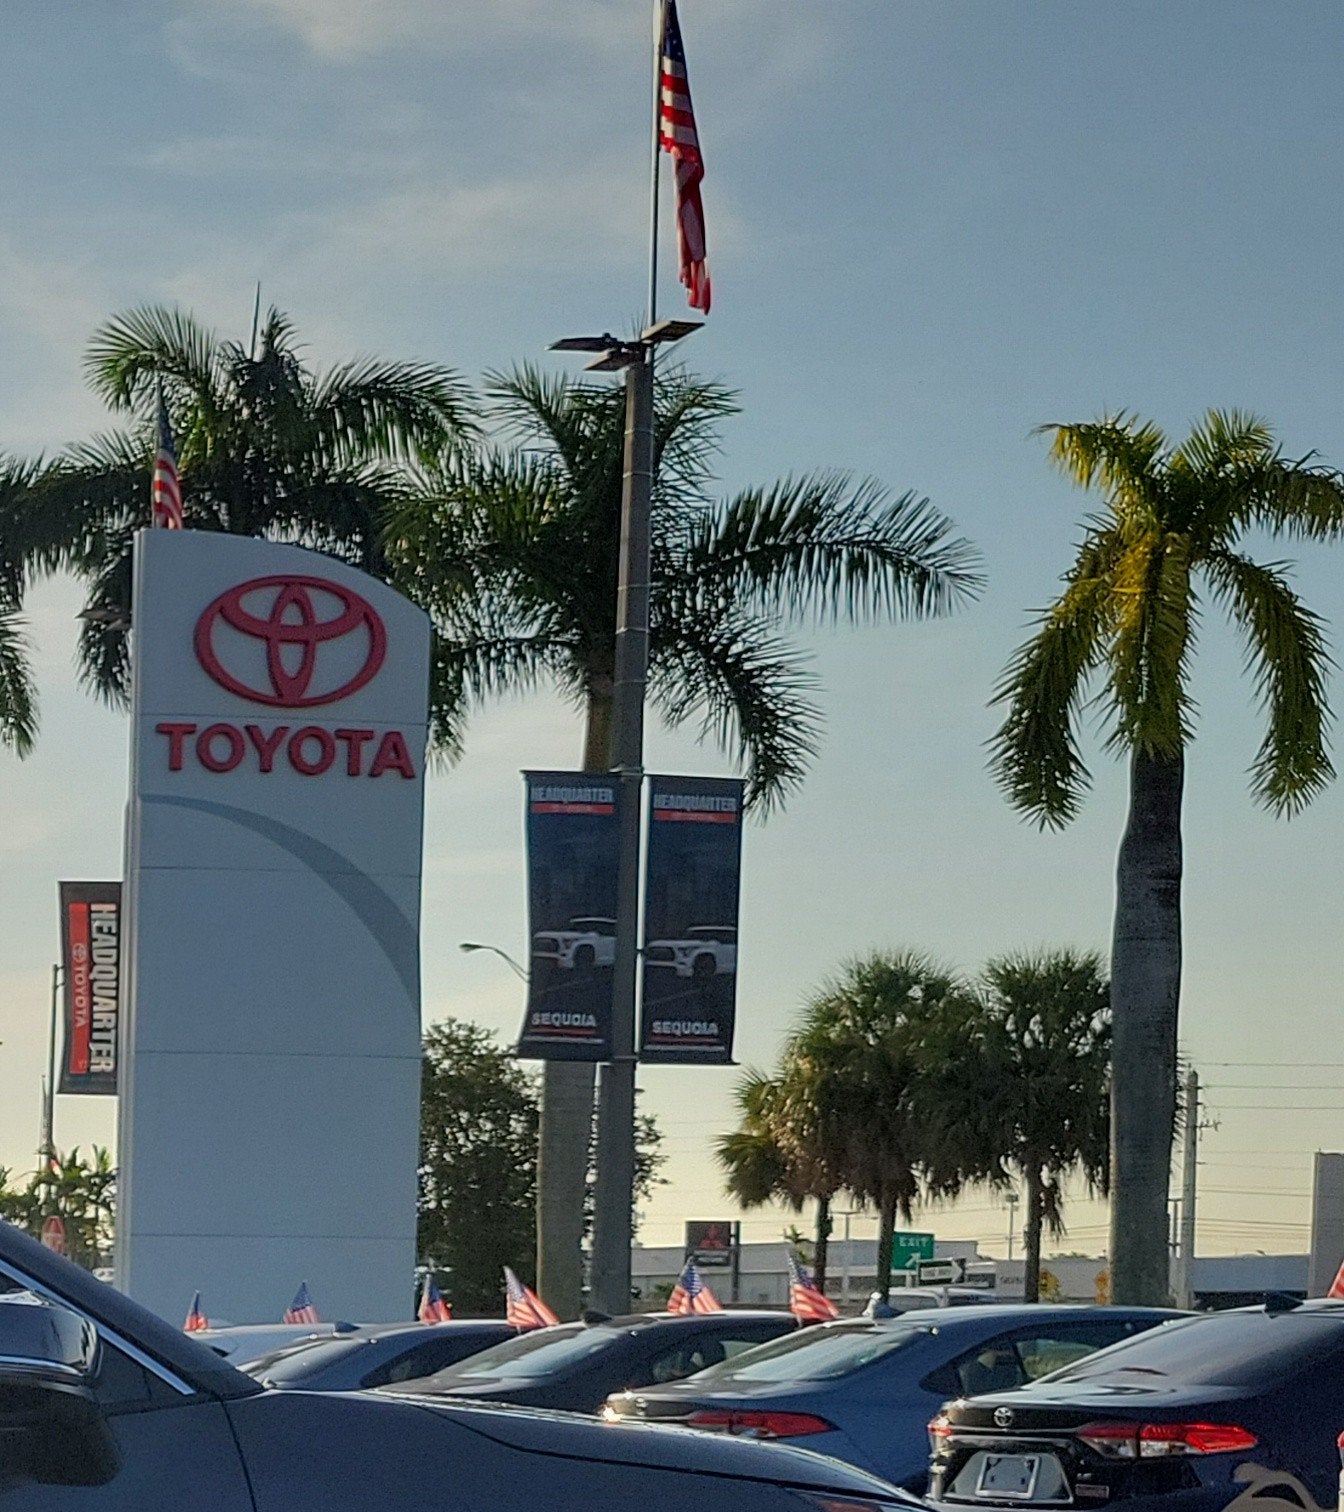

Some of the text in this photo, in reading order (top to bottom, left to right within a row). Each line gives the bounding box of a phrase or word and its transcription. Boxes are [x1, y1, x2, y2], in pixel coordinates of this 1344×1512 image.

[155, 723, 416, 779] TOYOTA
[74, 963, 89, 1027] TOYOTA
[89, 903, 118, 1073] HEADQUARTER
[531, 1012, 597, 1027] SEQUOIA
[652, 1021, 720, 1036] SEQUOIA
[899, 1236, 928, 1247] EXIT
